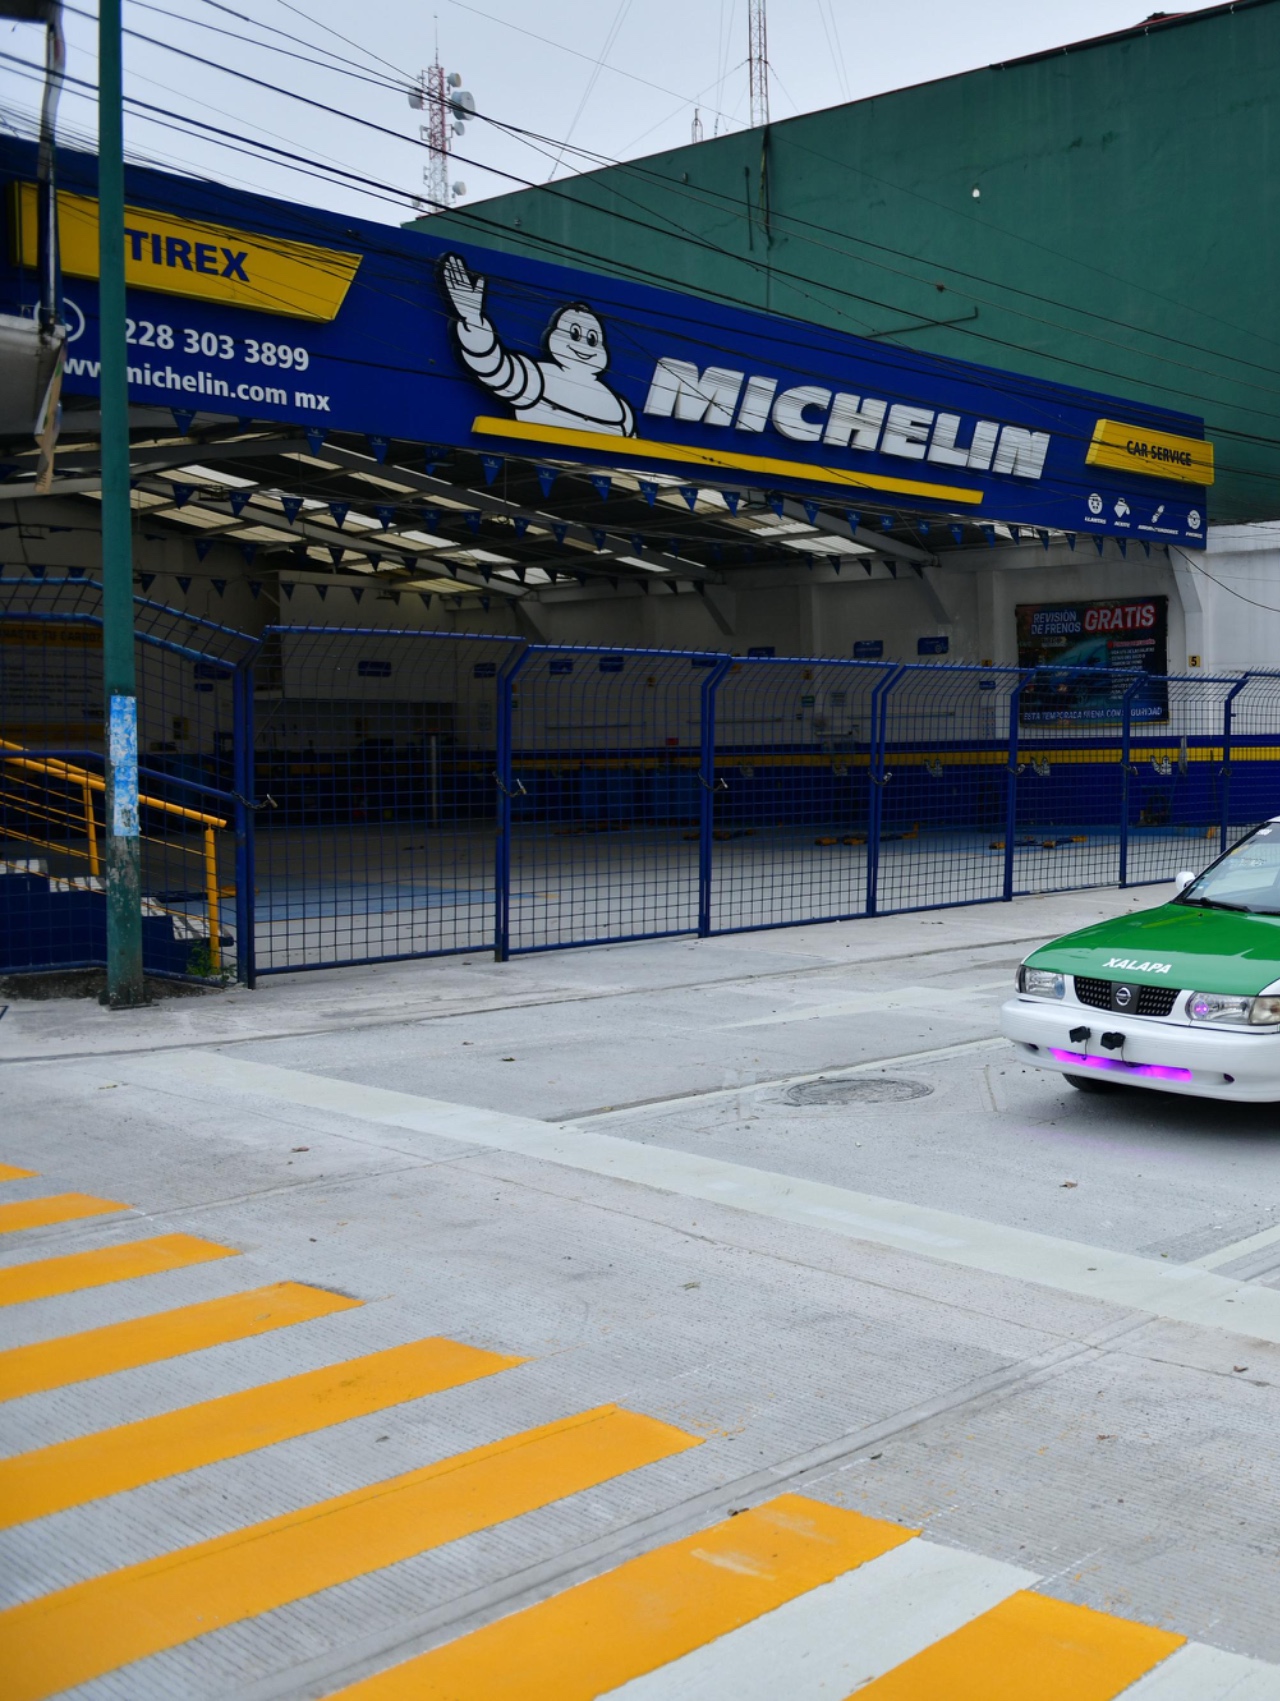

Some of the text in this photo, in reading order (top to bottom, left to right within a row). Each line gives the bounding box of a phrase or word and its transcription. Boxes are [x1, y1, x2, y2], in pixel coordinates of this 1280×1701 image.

[124, 228, 249, 282] TIREX
[125, 318, 310, 372] 228 303 3899
[294, 390, 331, 412] mx
[643, 357, 1051, 480] MICHELIN
[1126, 440, 1192, 467] CAR SERVICE
[1031, 622, 1081, 635] DE FRENOS
[1034, 605, 1155, 631] REVISIÓN GRATIS
[1191, 656, 1197, 667] 5
[1102, 957, 1172, 974] XALAPA
